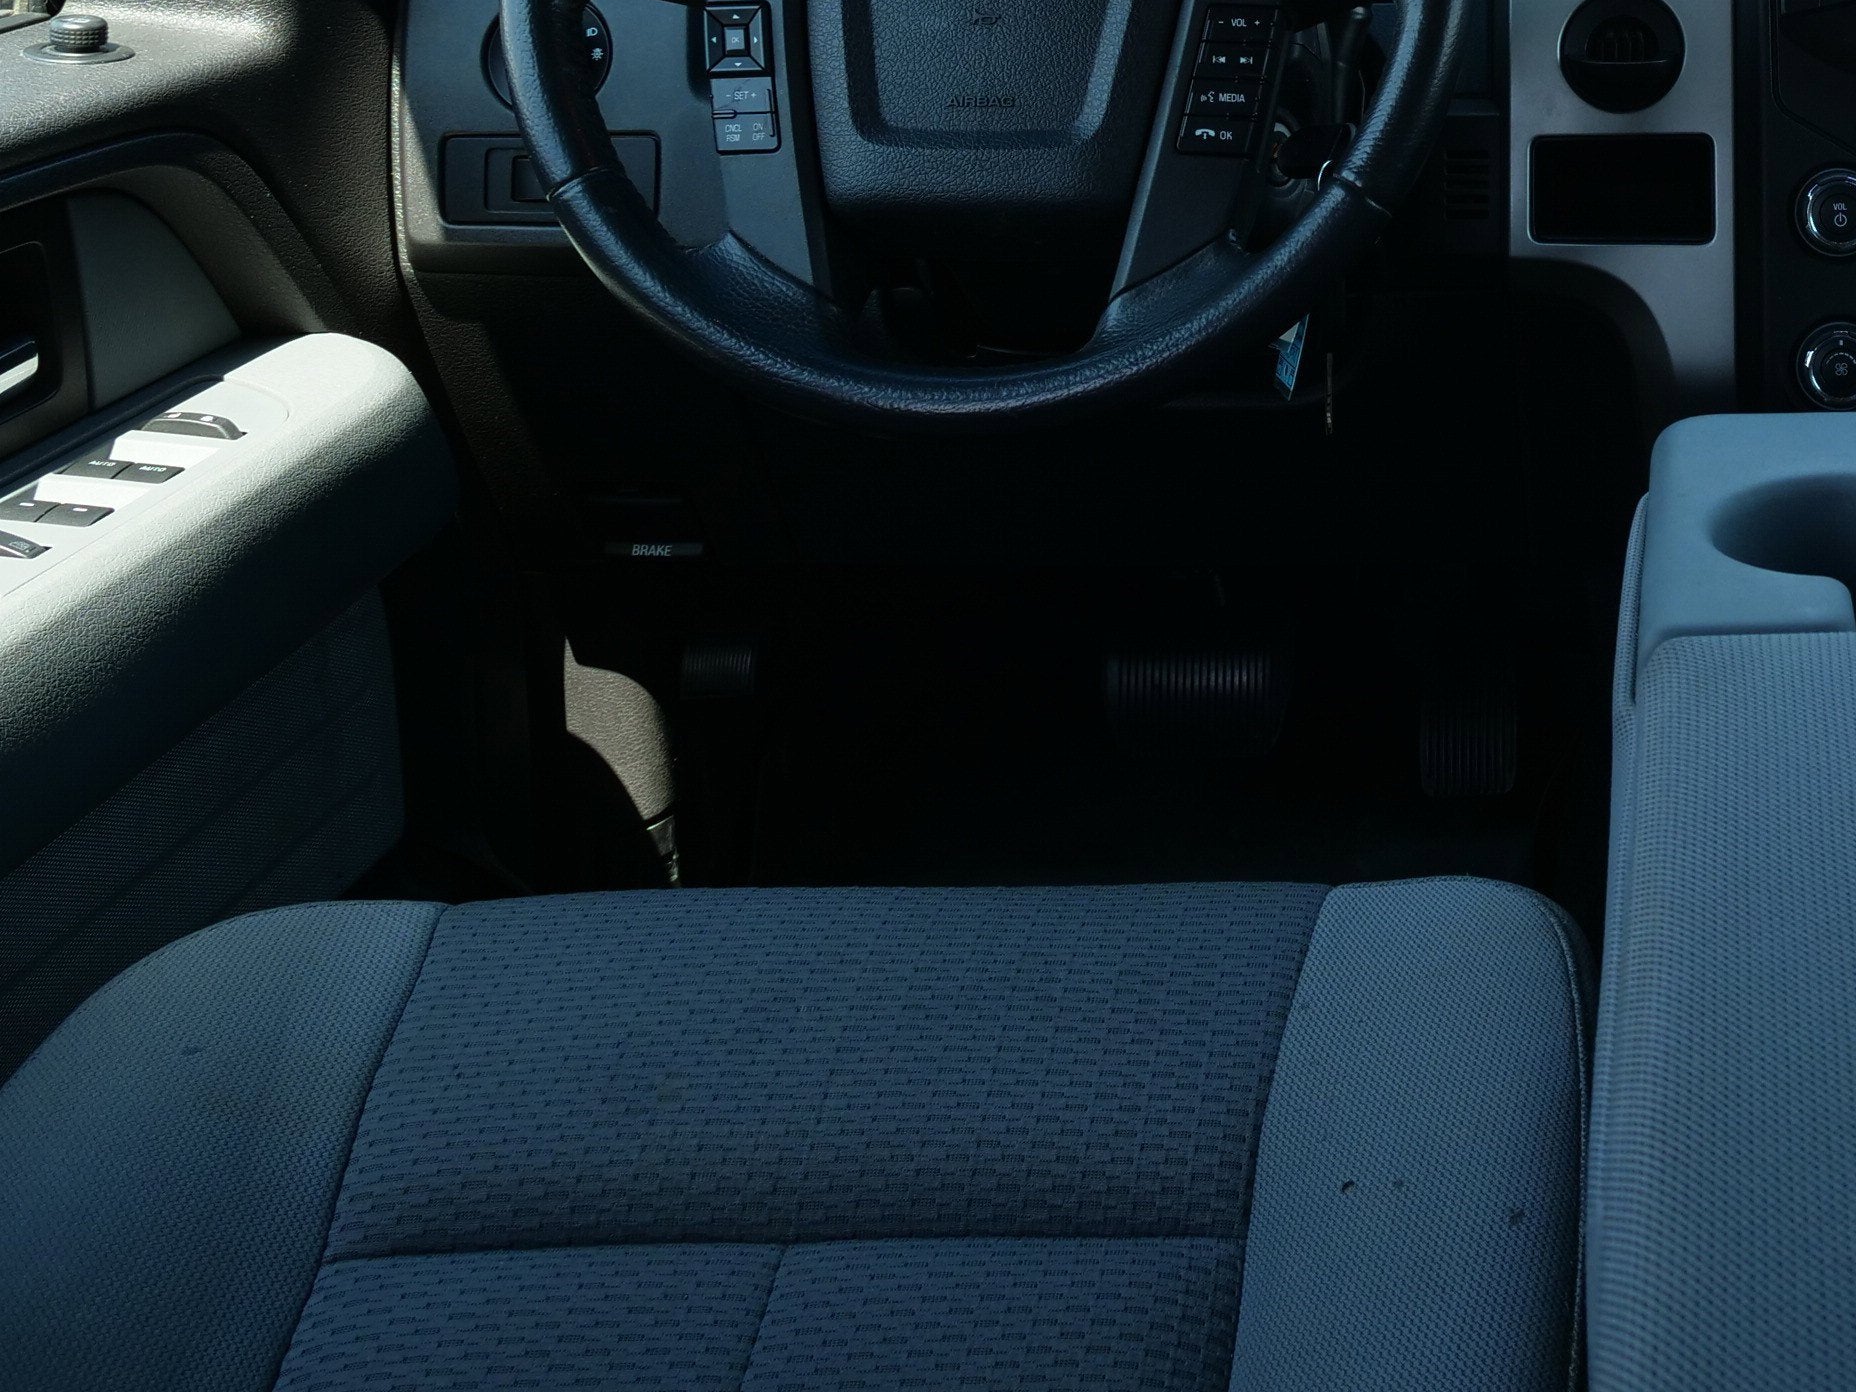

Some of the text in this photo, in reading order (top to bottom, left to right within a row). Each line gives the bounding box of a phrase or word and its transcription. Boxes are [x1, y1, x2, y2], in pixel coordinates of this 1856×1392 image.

[1231, 18, 1247, 27] VOL
[734, 91, 749, 100] SET
[1218, 93, 1245, 102] MEDIA
[1219, 130, 1233, 140] OK
[1833, 203, 1847, 211] VOL
[632, 544, 673, 557] BRAKE
